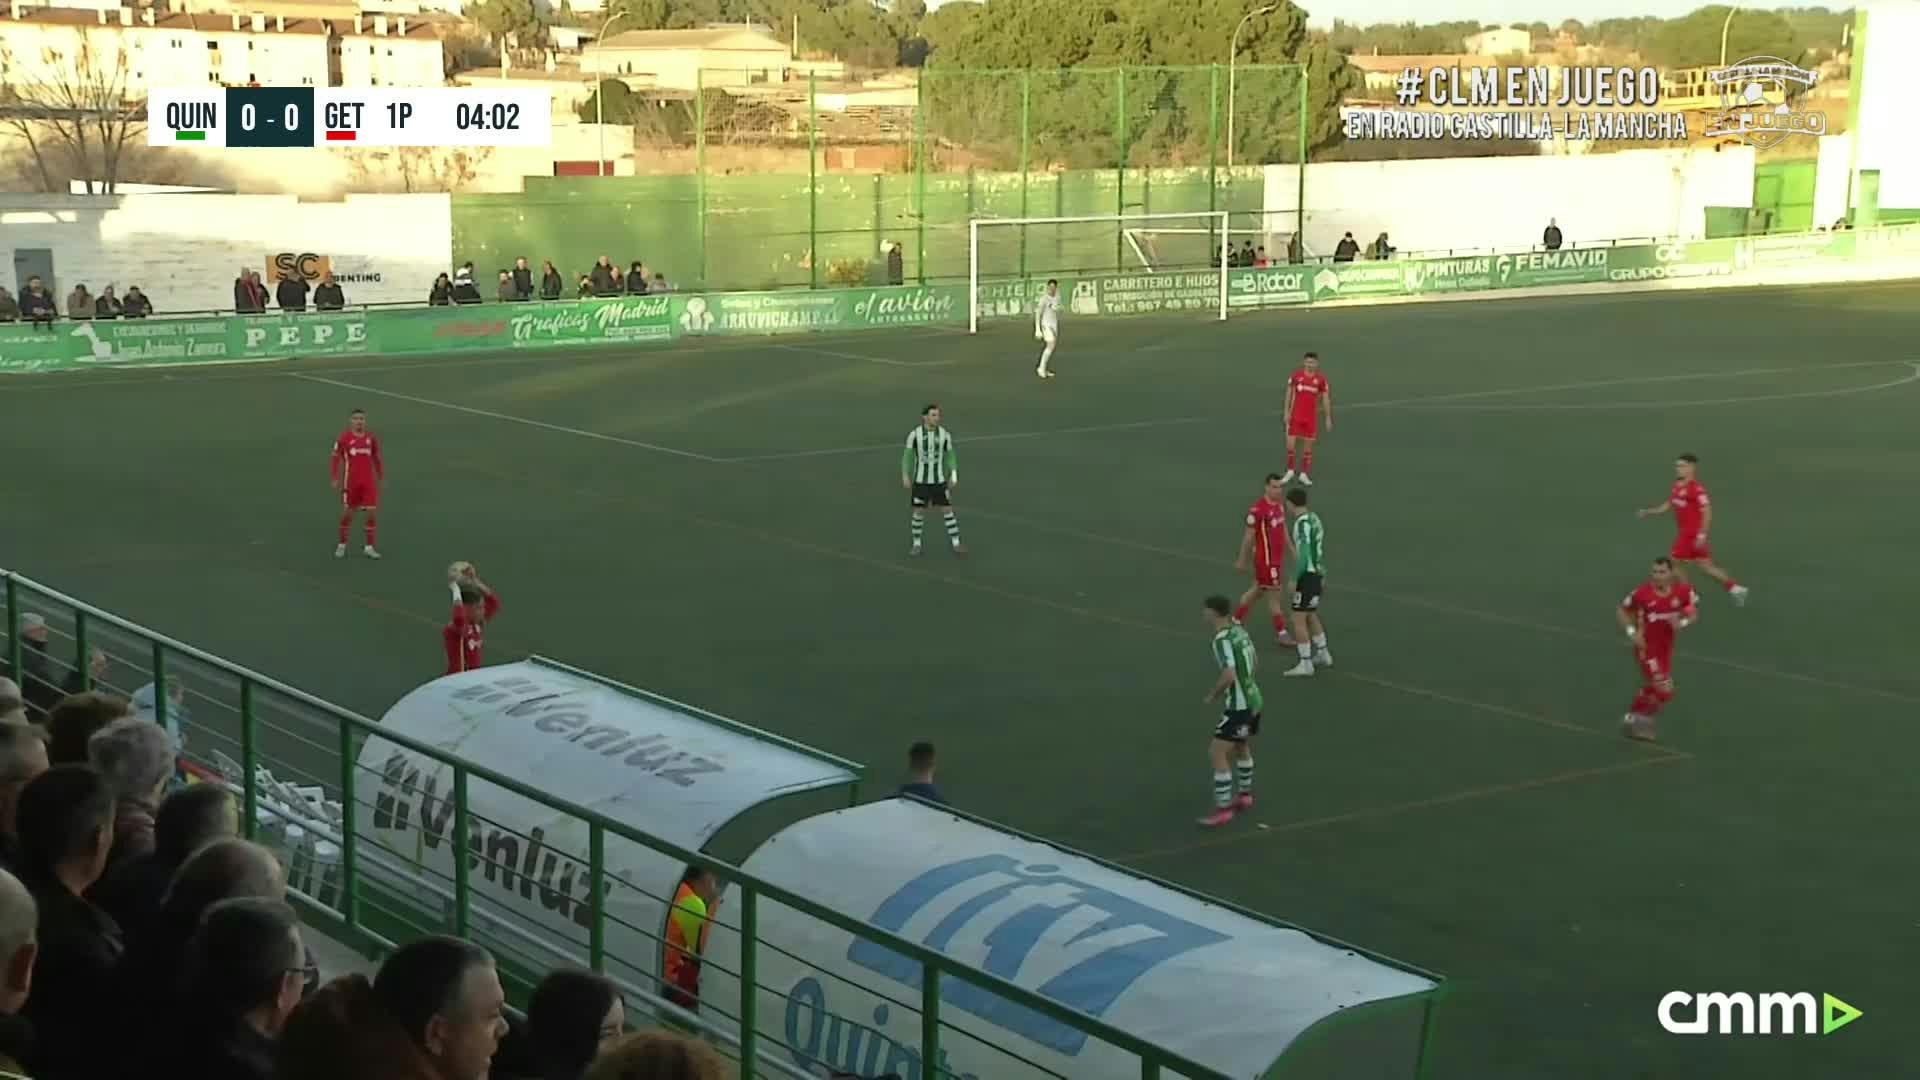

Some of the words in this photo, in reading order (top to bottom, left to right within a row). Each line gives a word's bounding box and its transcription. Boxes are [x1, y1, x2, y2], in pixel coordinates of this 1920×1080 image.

[275, 253, 320, 280] SC
[1425, 257, 1490, 278] PINTURAS
[1515, 248, 1608, 271] FEMAVID
[1103, 277, 1173, 290] CARRETERO
[1175, 276, 1182, 288] E
[1186, 274, 1219, 287] HIJOS
[595, 297, 668, 326] Madrid
[854, 292, 876, 321] el
[879, 288, 953, 314] avión
[246, 323, 367, 347] PEPE
